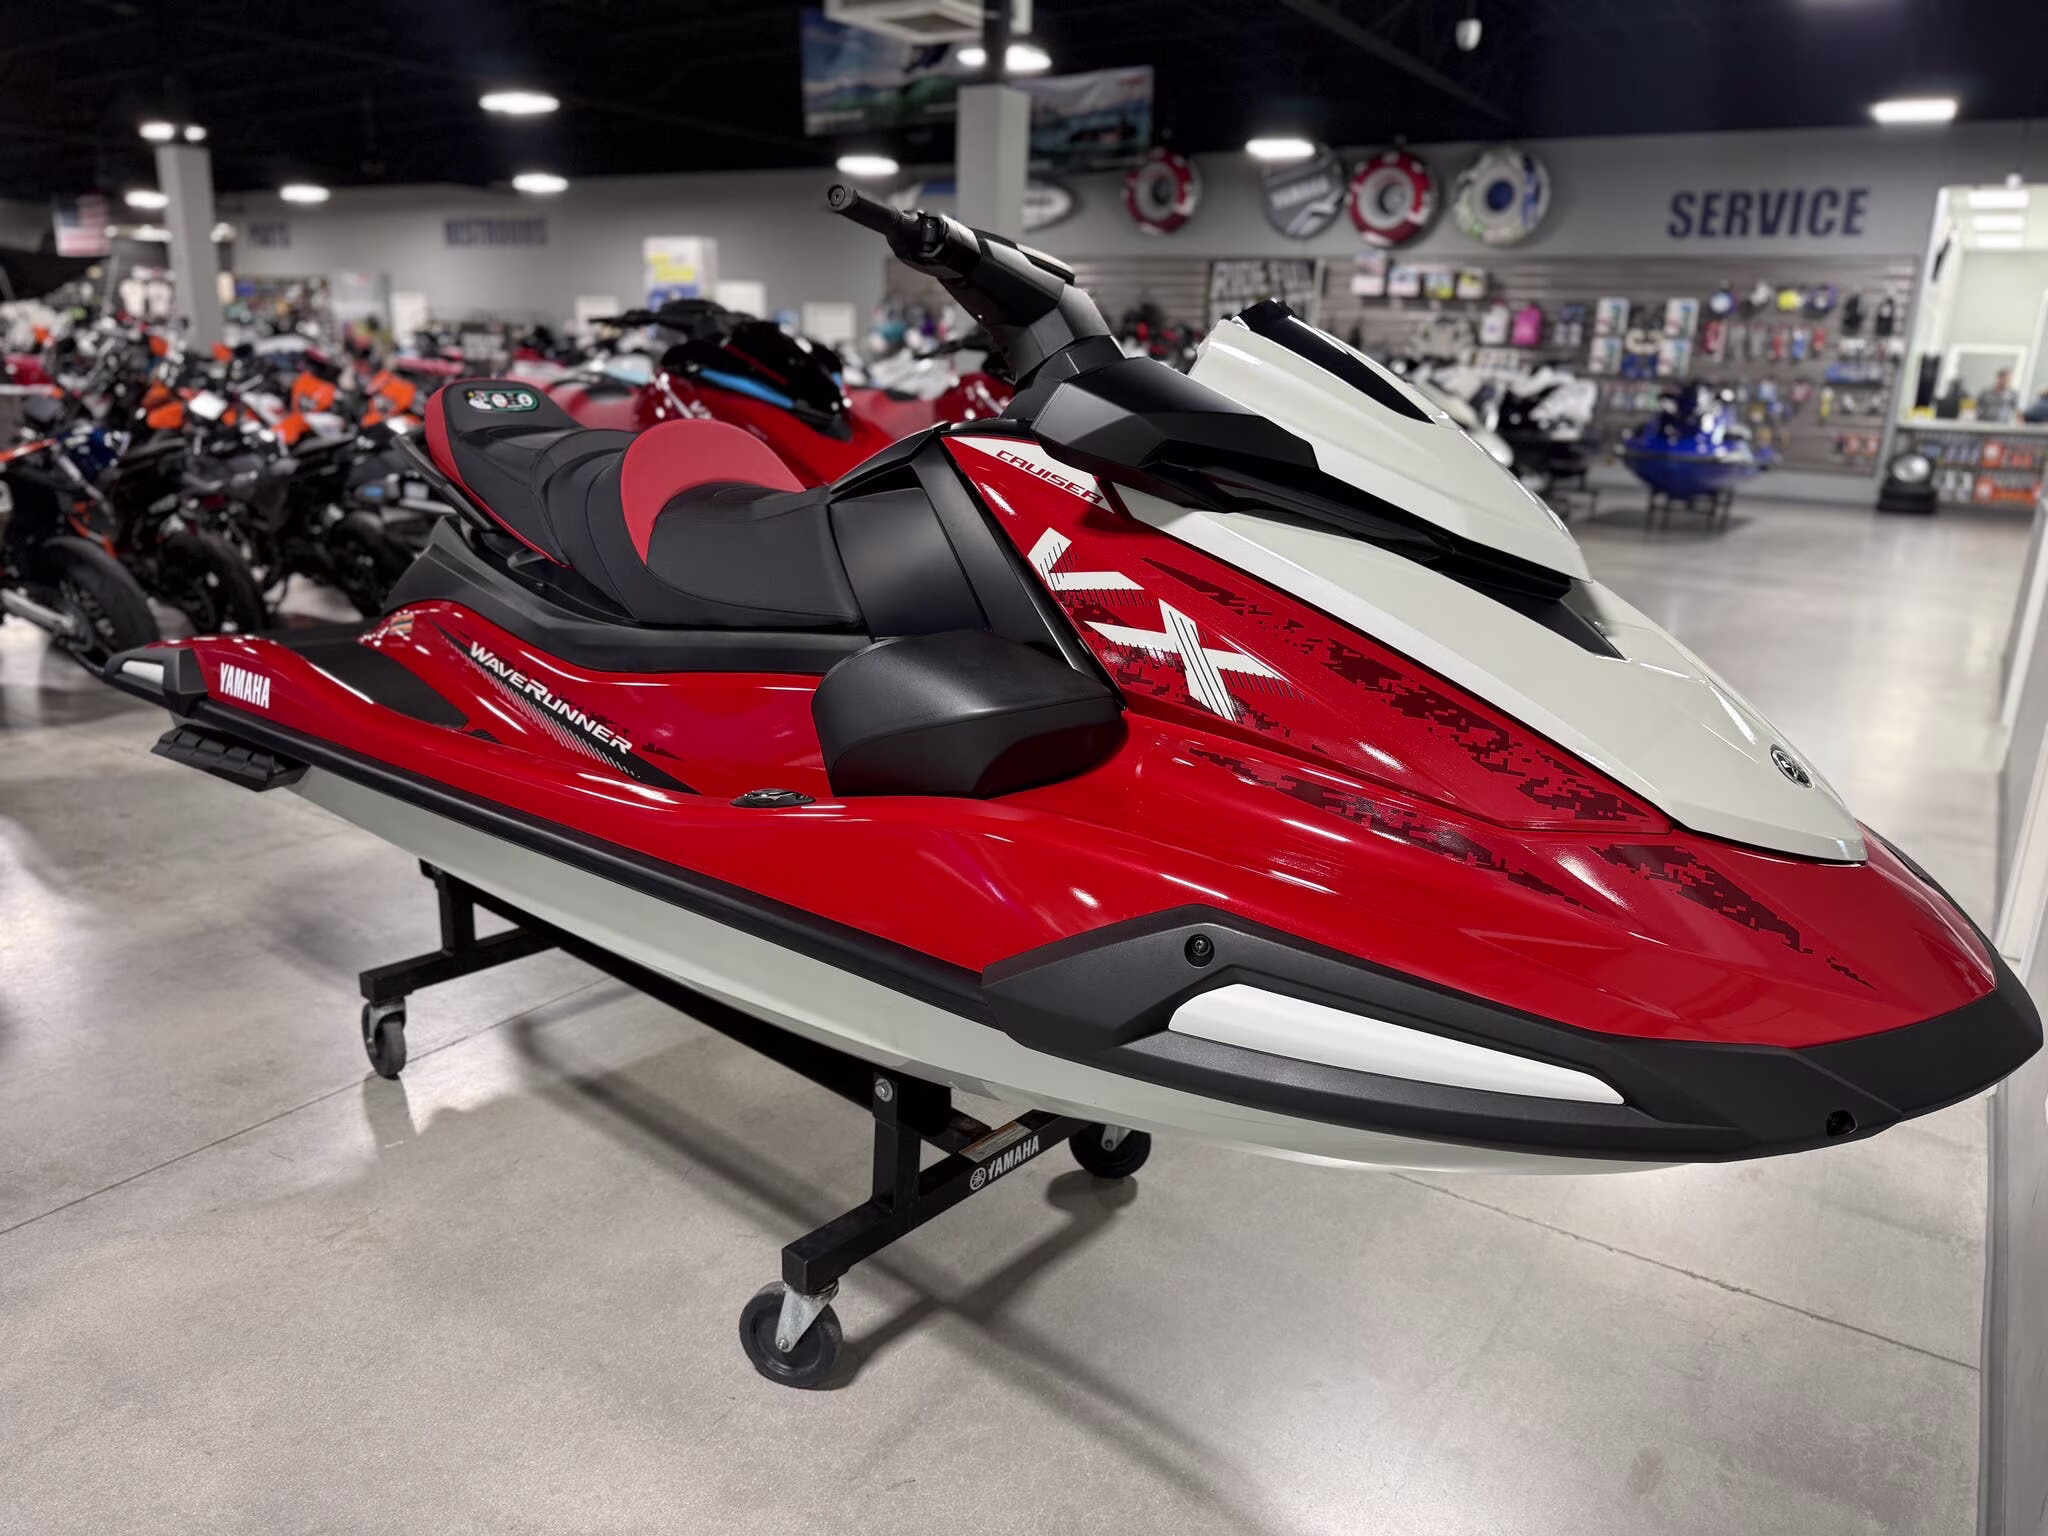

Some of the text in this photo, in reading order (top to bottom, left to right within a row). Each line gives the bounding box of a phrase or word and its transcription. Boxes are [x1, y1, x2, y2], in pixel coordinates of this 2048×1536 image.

[1666, 186, 1870, 238] SERVICE
[995, 450, 1104, 505] CRUISER
[1027, 527, 1292, 723] VX
[220, 661, 271, 710] YAMAHA
[469, 640, 633, 755] WAVERUNNER
[987, 1134, 1040, 1181] YAMAHA
